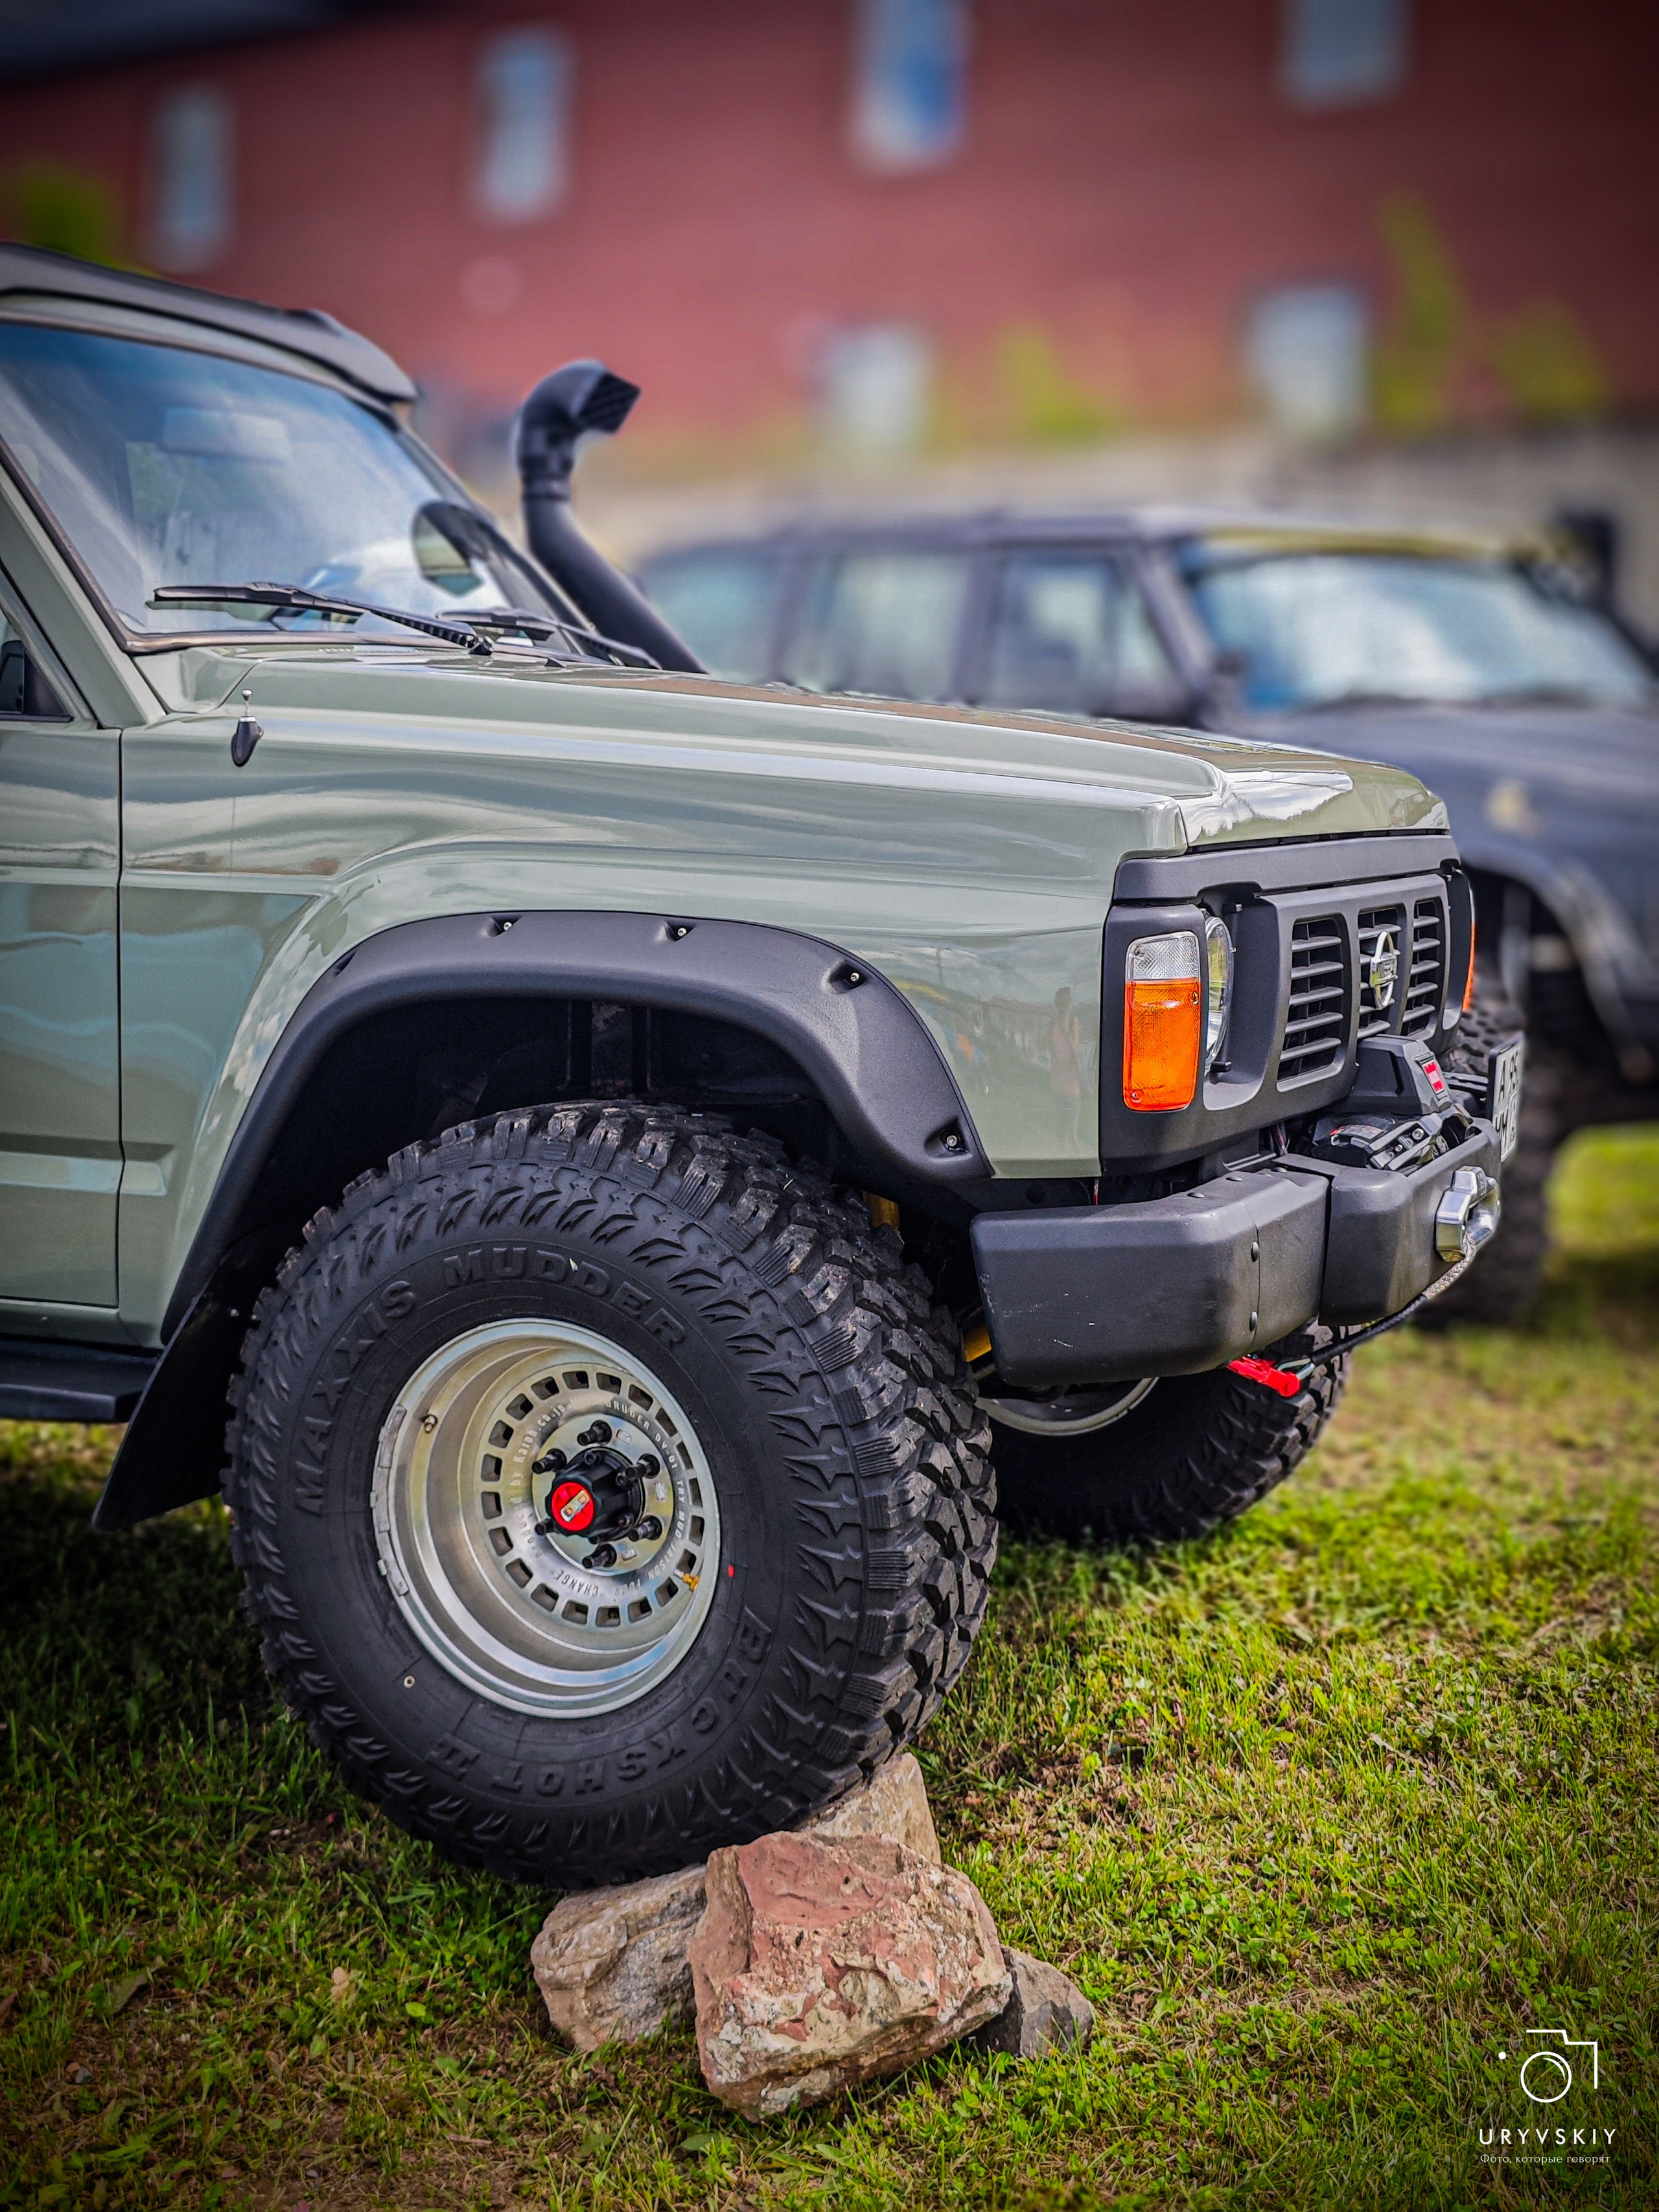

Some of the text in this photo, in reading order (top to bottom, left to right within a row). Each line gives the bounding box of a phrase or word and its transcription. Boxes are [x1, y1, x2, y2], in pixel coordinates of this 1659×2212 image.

[294, 1246, 686, 1517] MAXXIS MUDDER
[675, 1509, 686, 1540] MUD
[676, 1479, 686, 1504] TRY
[490, 1605, 772, 1797] BUCKSHOT
